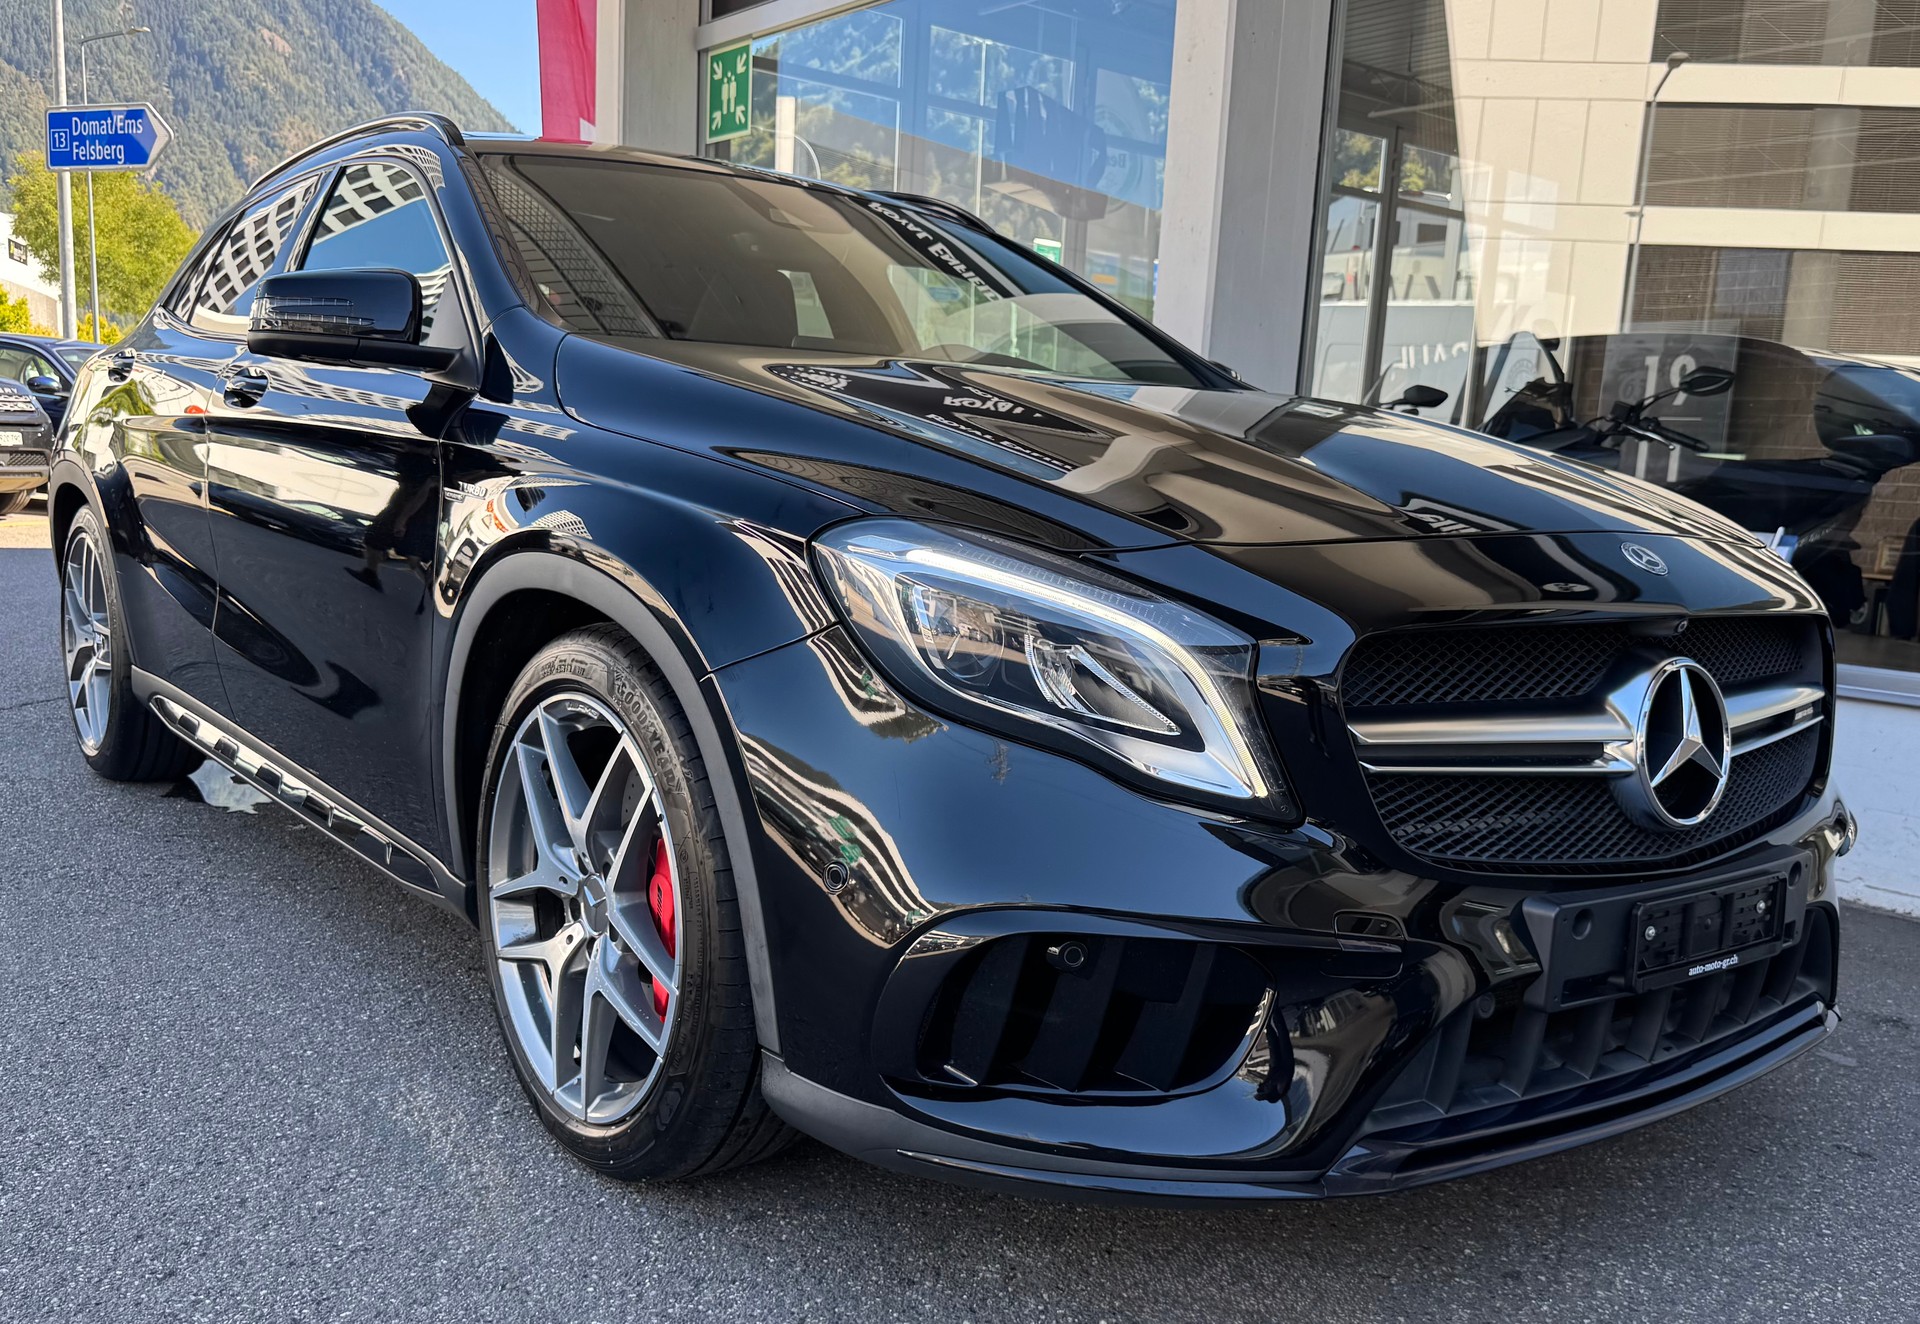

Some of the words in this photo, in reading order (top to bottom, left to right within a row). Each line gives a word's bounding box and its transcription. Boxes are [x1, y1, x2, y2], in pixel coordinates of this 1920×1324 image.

[72, 115, 143, 136] Domat/Ems
[54, 132, 66, 148] 13
[72, 140, 125, 164] Felsberg
[458, 481, 487, 497] TURBO
[615, 680, 678, 789] GOODYEAR
[1688, 954, 1739, 976] auto-moto-gr.ch
